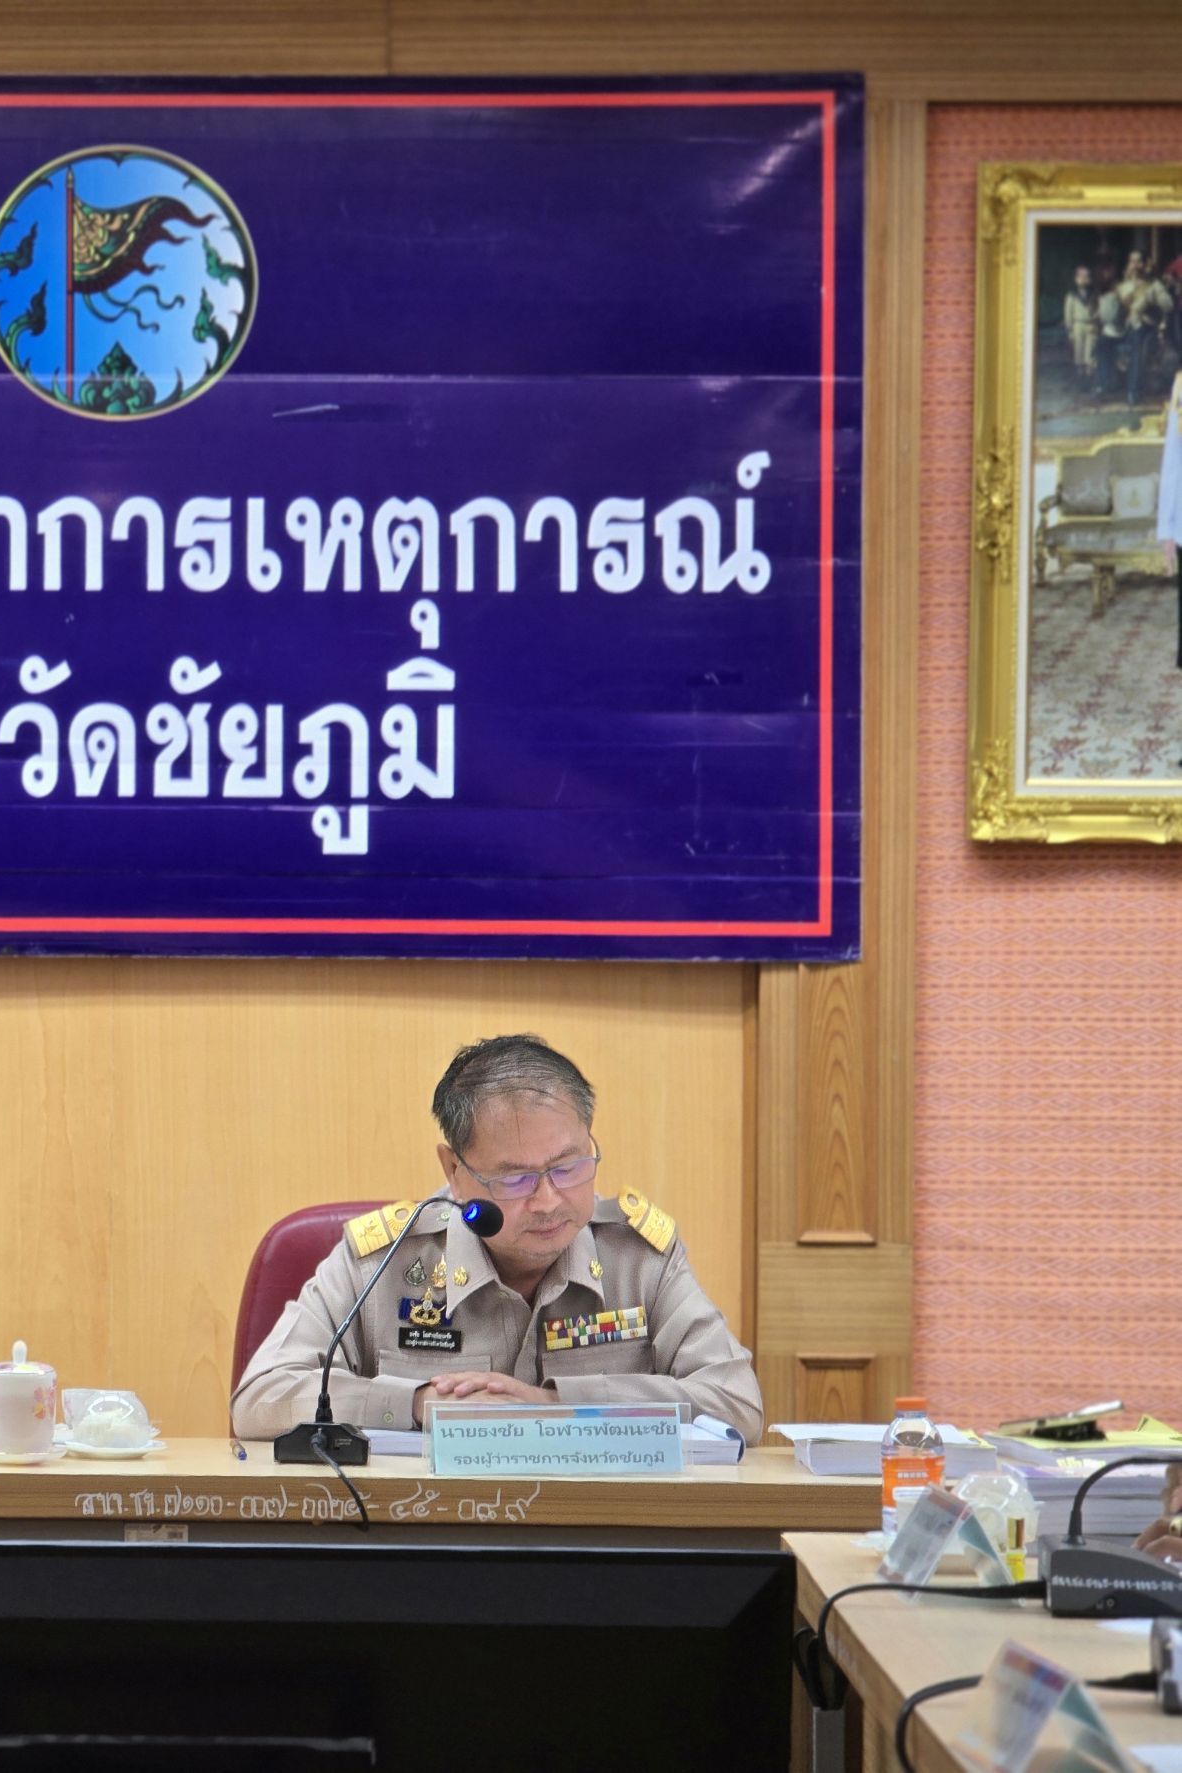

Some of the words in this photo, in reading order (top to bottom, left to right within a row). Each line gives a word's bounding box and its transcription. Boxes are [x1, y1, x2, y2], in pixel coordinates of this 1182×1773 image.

[440, 1421, 525, 1438] นายธงชัย
[453, 1450, 666, 1468] รองผู้ว่าราชการจังหวัดชัยภูมิ
